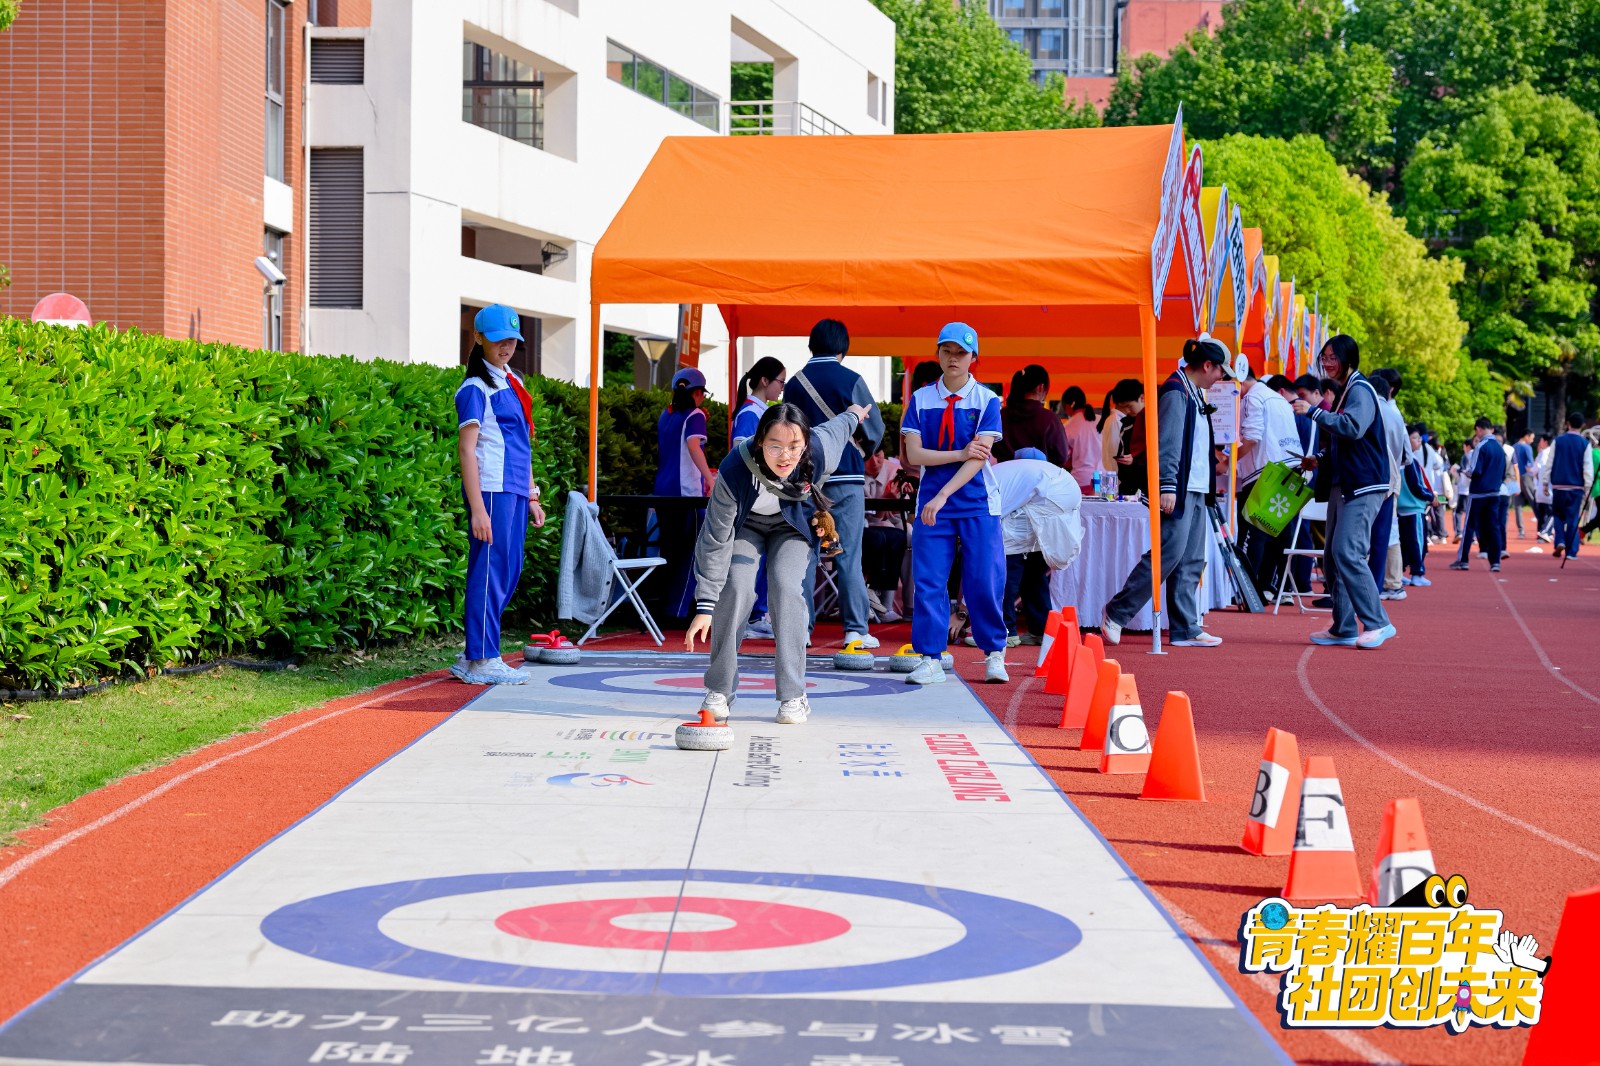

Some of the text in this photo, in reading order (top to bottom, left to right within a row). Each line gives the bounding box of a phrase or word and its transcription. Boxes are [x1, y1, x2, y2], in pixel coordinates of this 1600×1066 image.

[1110, 713, 1149, 753] C
[921, 733, 1012, 802] FLOOR CURLING
[1248, 769, 1272, 819] B
[1293, 793, 1345, 850] F
[211, 1009, 1074, 1048] 助力三亿人参与冰雪
